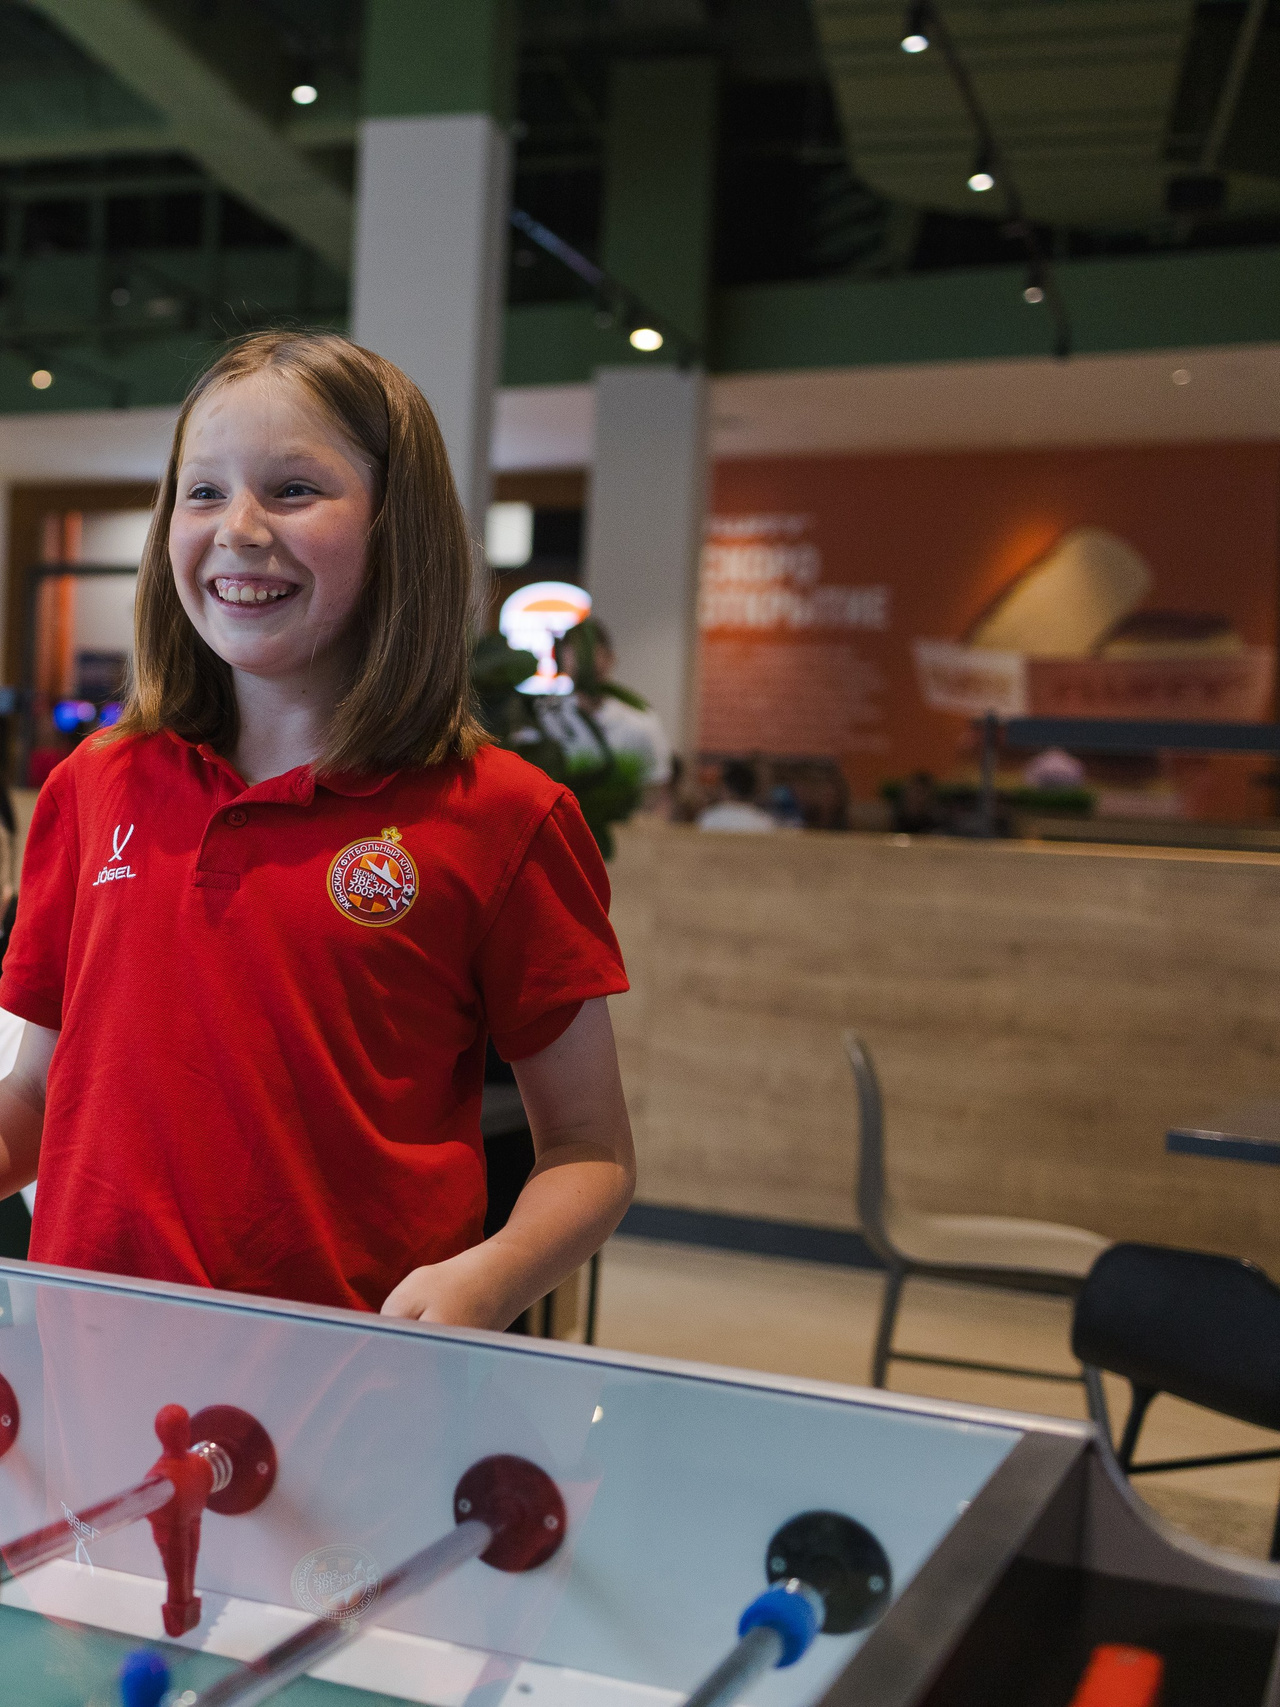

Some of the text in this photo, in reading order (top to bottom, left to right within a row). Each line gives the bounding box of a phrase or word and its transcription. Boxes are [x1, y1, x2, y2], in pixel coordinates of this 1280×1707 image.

[333, 843, 413, 910] ЖЕНСКИЙ ФУТБОЛЬНЫЙ КЛУБ
[349, 873, 394, 898] ЗВЕЗДА
[347, 882, 375, 898] 2005
